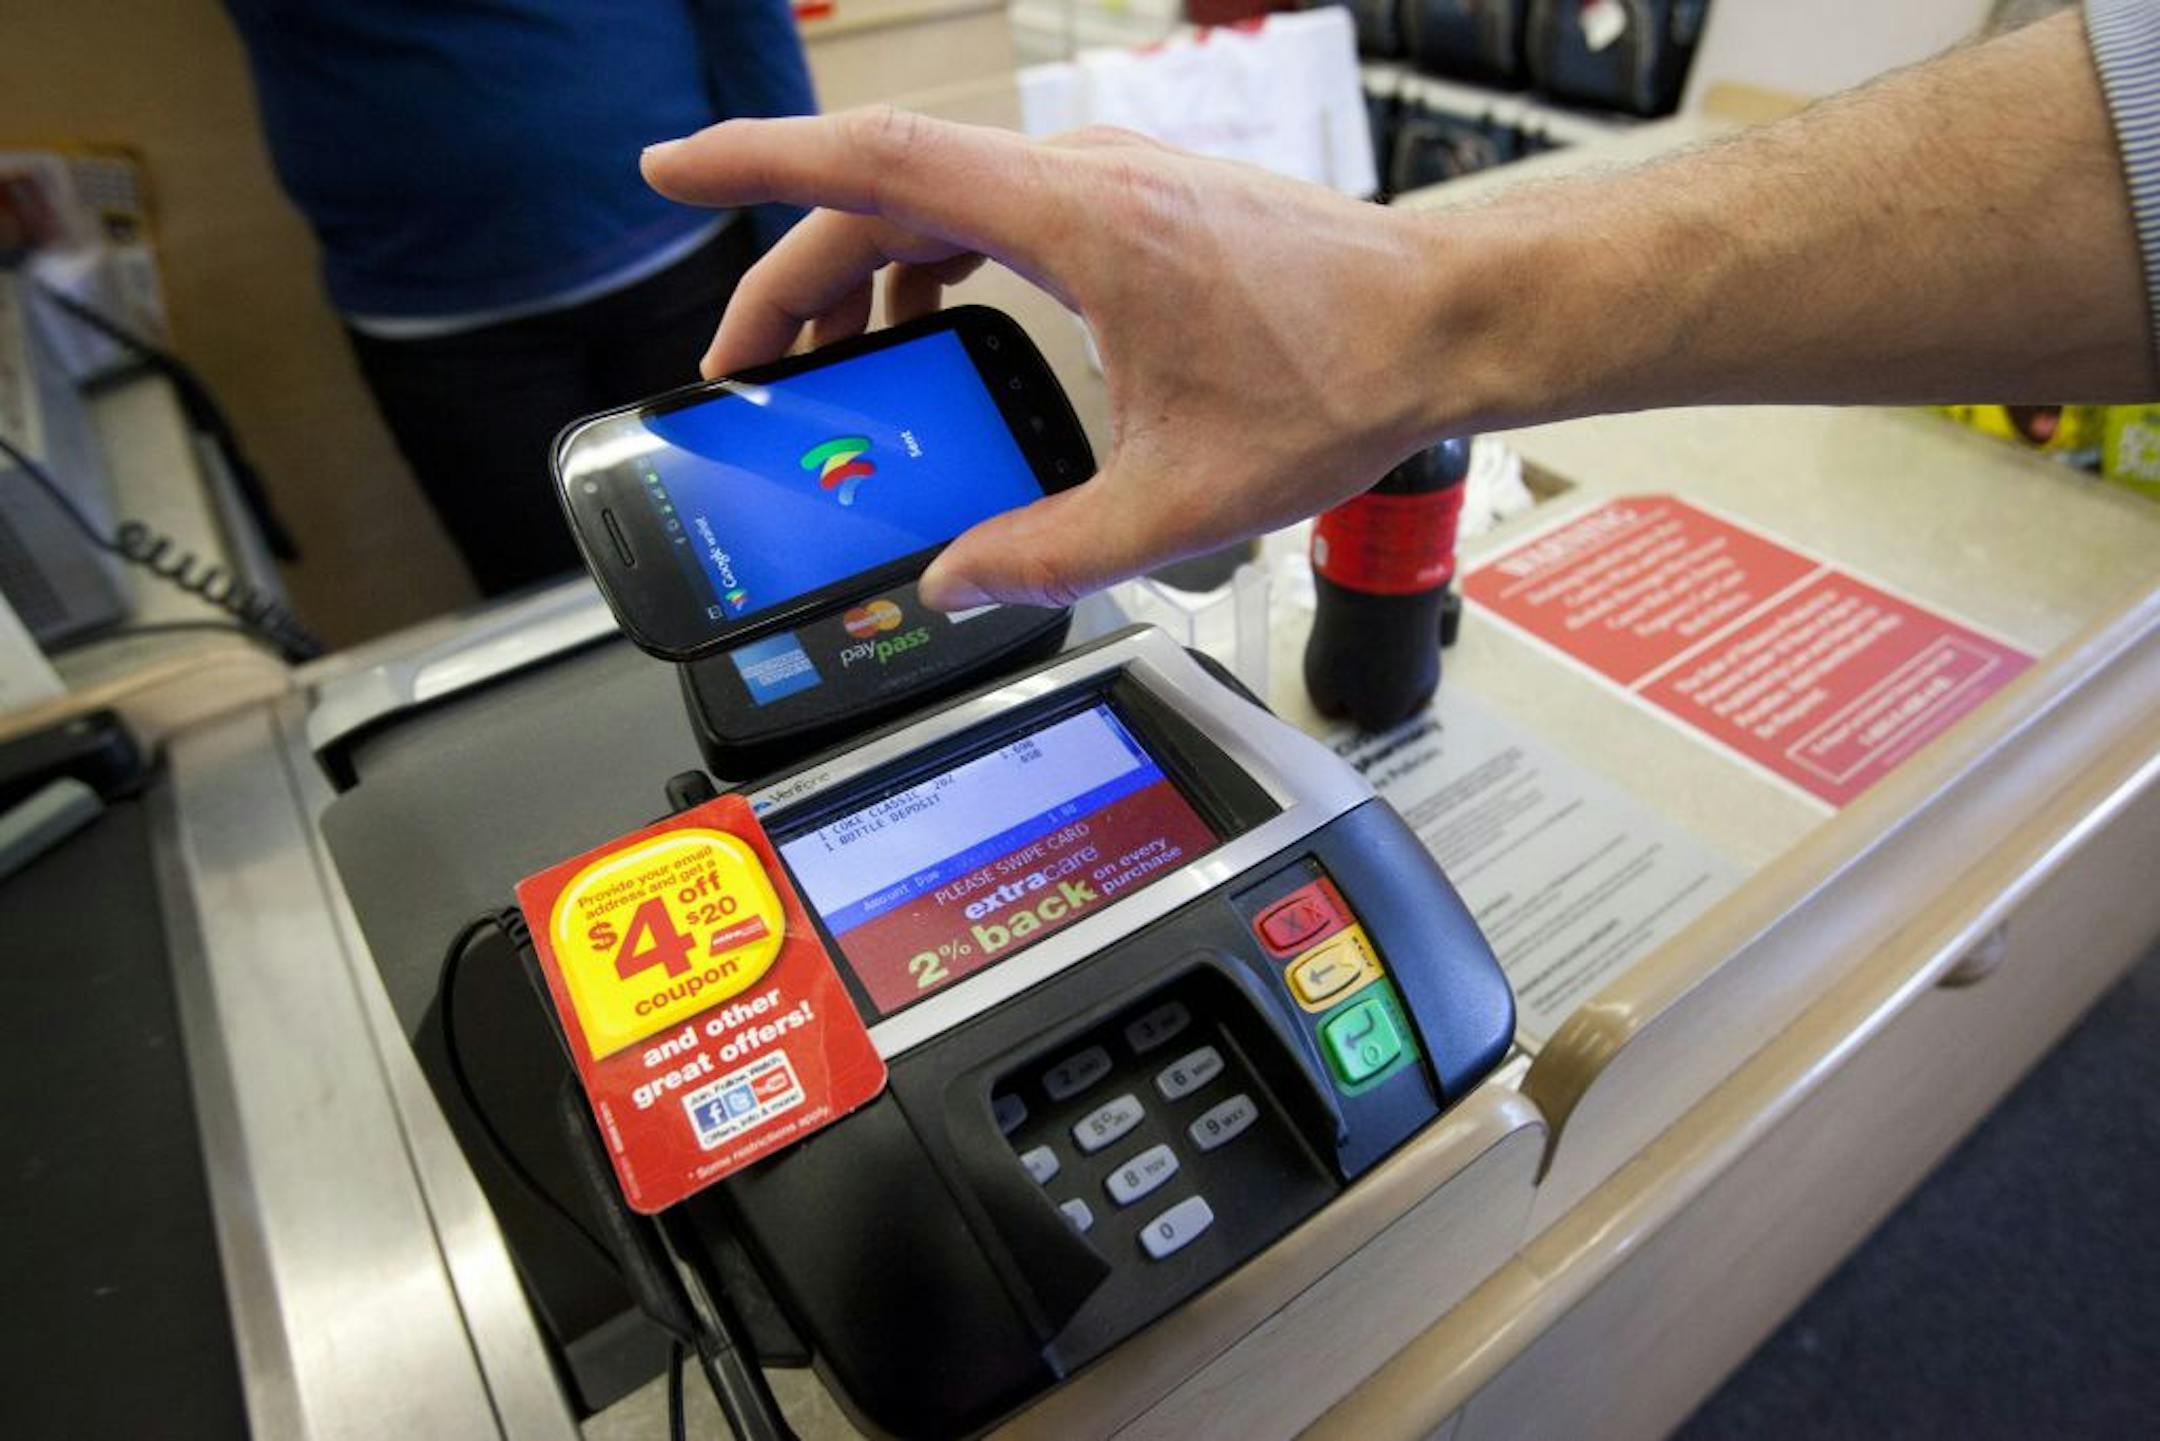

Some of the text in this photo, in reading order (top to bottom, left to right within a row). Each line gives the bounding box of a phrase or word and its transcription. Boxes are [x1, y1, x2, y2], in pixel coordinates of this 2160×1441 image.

[711, 547, 737, 588] Google
[832, 815, 863, 834] COKE
[868, 791, 921, 818] CLASSIC
[838, 819, 883, 846] BOTTLE
[890, 793, 942, 823] DEPOSIT
[577, 845, 712, 908] Provide your email
[934, 822, 1091, 905] PLEASE SWIPE CARD
[1092, 836, 1169, 881] on every
[1101, 846, 1183, 895] purchase
[586, 887, 646, 920] address
[649, 875, 677, 893] and
[680, 862, 704, 883] get
[678, 870, 723, 904] off
[863, 882, 909, 911] Amount
[914, 871, 940, 889] Due
[685, 896, 738, 925] $20
[587, 896, 697, 982] $4
[908, 878, 1098, 989] 2% back
[643, 988, 781, 1068] and other
[632, 1000, 815, 1109] great offers!
[1173, 1069, 1187, 1087] 6
[1090, 1119, 1106, 1137] 5
[1206, 1119, 1220, 1136] 9
[696, 1156, 732, 1180] Some
[732, 1123, 797, 1161] restrictions
[1123, 1170, 1140, 1188] 8
[1159, 1222, 1175, 1240] 0
